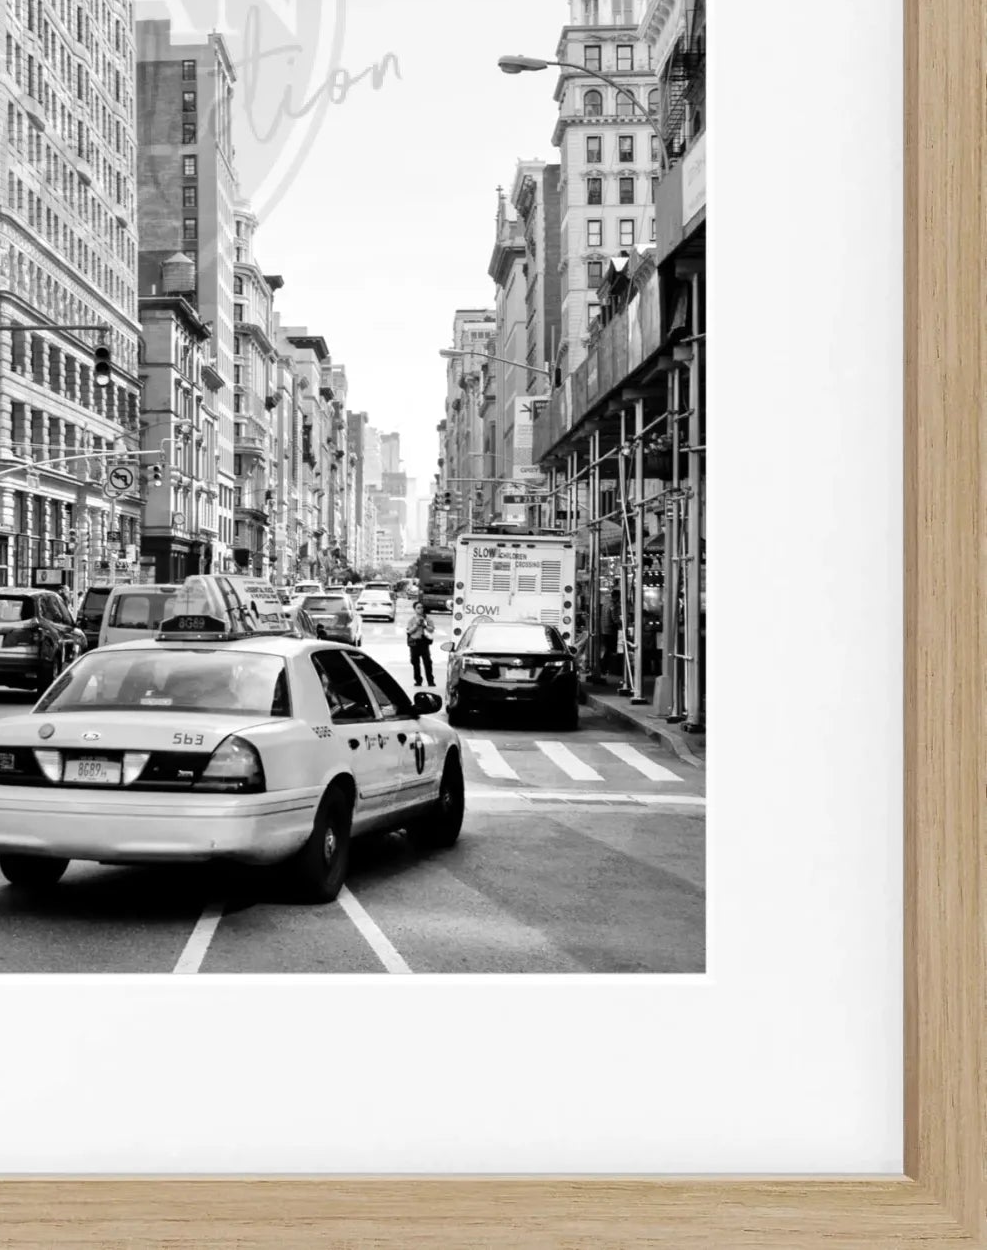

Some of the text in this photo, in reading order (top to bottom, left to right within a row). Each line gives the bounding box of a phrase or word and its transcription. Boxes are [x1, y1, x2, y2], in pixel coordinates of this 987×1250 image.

[473, 547, 497, 558] SLOW
[465, 604, 500, 616] SLOW!
[178, 617, 206, 629] 8G89
[172, 732, 204, 746] 563
